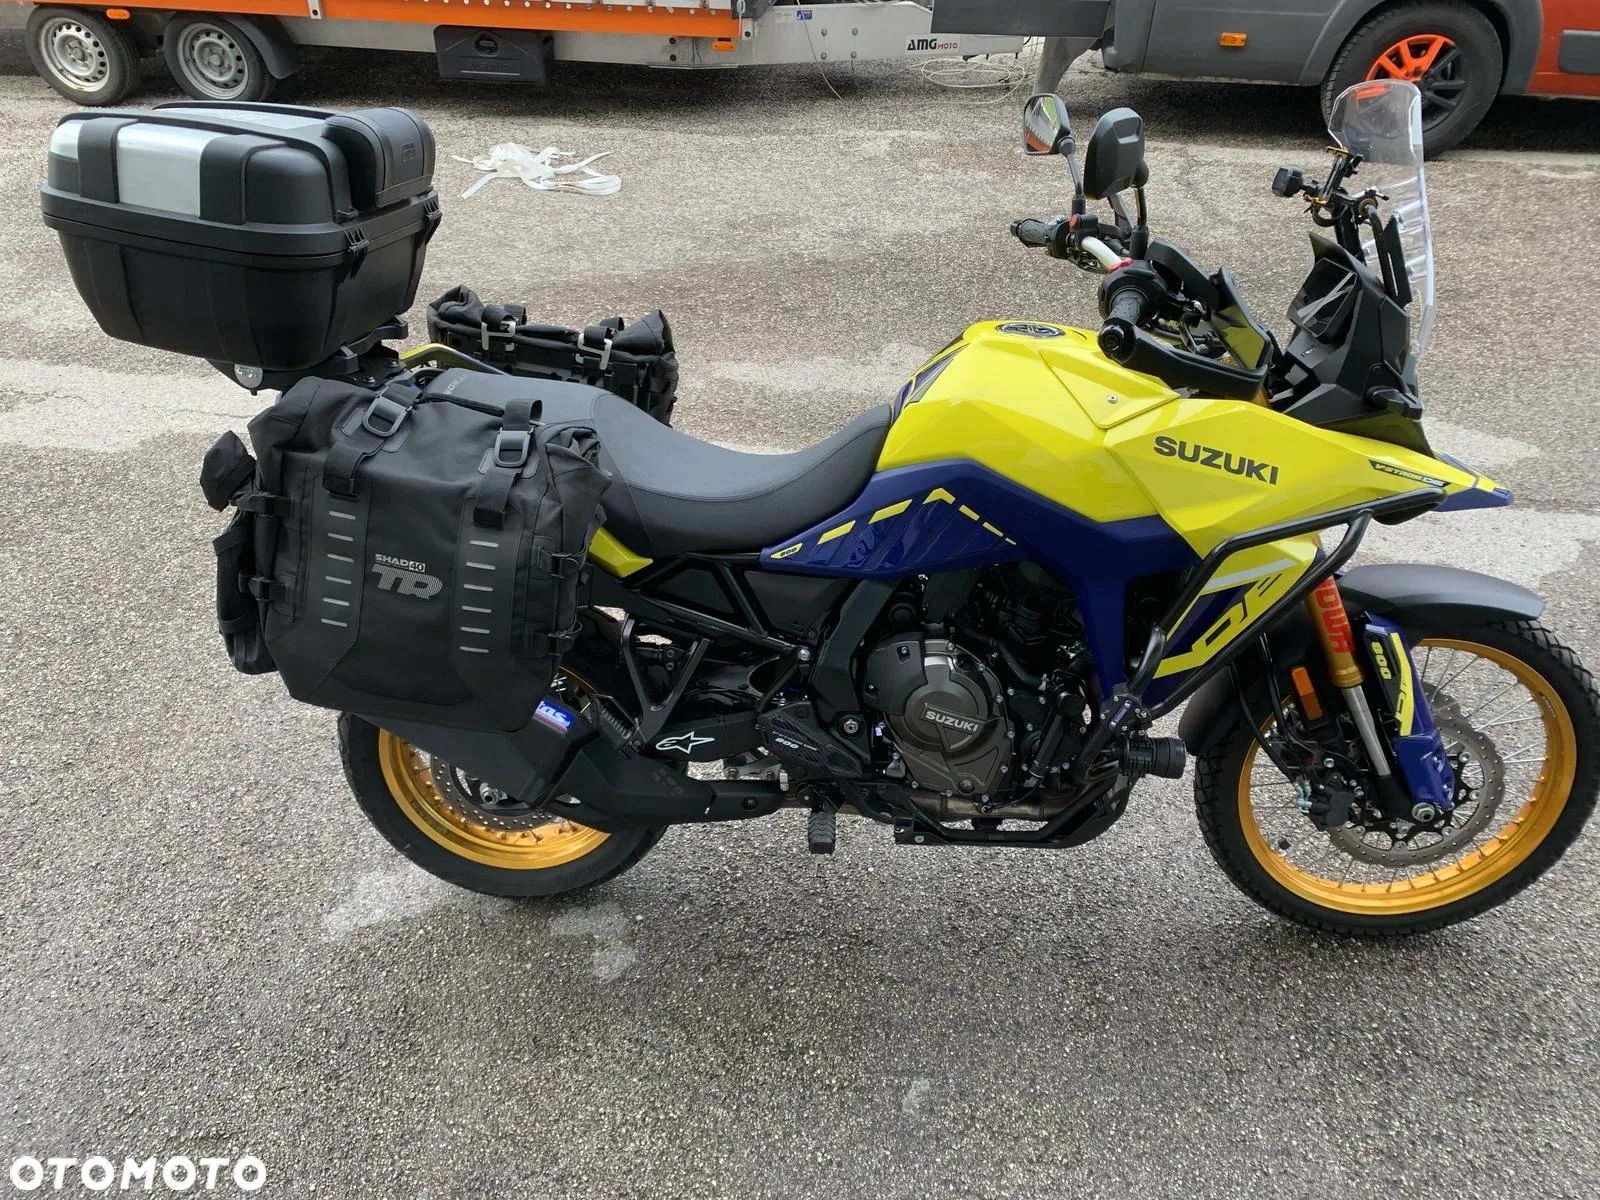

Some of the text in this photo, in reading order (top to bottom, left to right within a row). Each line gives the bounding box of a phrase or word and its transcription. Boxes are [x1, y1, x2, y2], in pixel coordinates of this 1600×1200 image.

[907, 38, 959, 51] AMG MOTO
[1153, 435, 1279, 486] SUZUKI
[375, 553, 409, 566] SHAD
[410, 561, 425, 572] 40
[925, 710, 979, 732] SUZUKI
